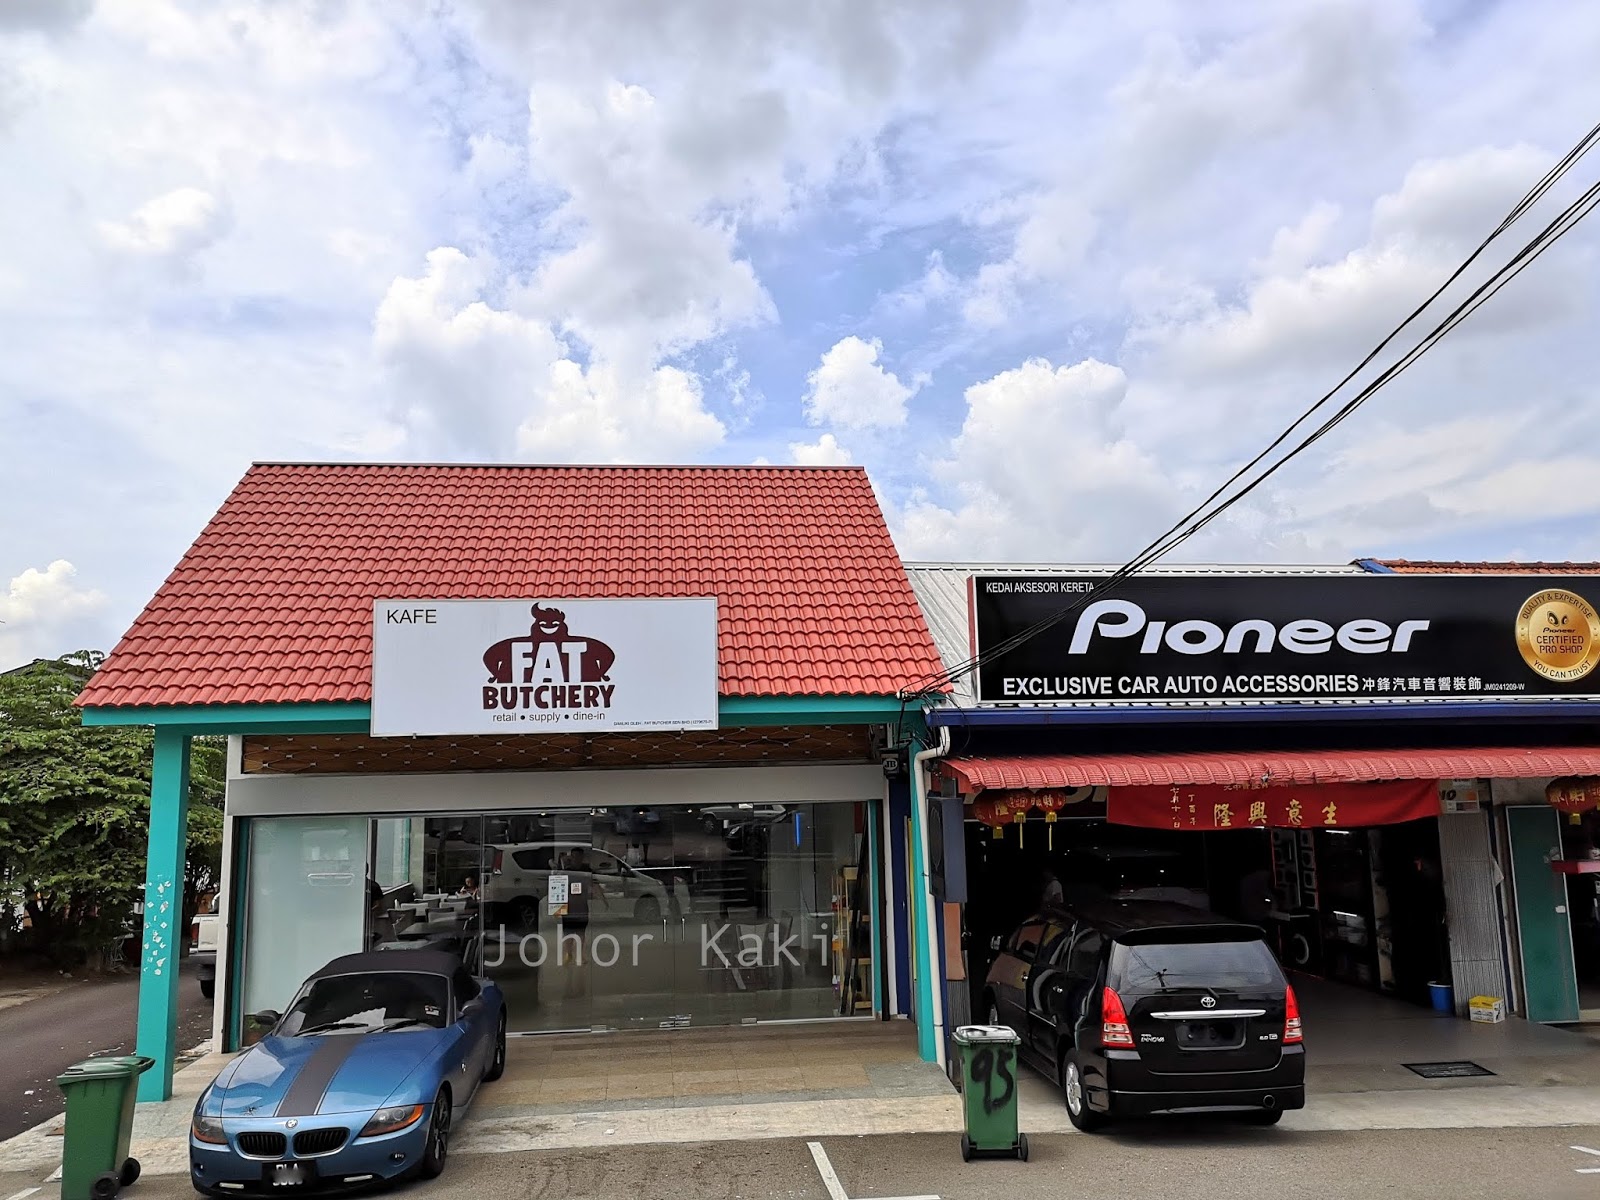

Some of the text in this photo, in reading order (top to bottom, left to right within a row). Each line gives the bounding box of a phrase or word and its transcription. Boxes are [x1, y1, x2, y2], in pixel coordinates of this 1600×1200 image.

[986, 582, 1095, 593] KEDAI AKSESORI KERETA
[1522, 593, 1593, 619] QUALITY & EXPERTISE
[387, 609, 437, 624] KAFE
[1068, 599, 1430, 655] Pioneer
[1536, 635, 1584, 644] CERTIFIED
[1539, 645, 1583, 654] PRO SHOP
[511, 641, 588, 683] FAT
[1534, 660, 1591, 678] YOU CAN TRUST
[1003, 674, 1359, 695] EXCLUSIVE CAR AUTO ACCESSORIES
[1483, 683, 1525, 691] JM0241209-W
[482, 684, 615, 709] BUTCHERY
[493, 711, 605, 723] retail supply dine-in
[970, 1048, 1014, 1117] 95
